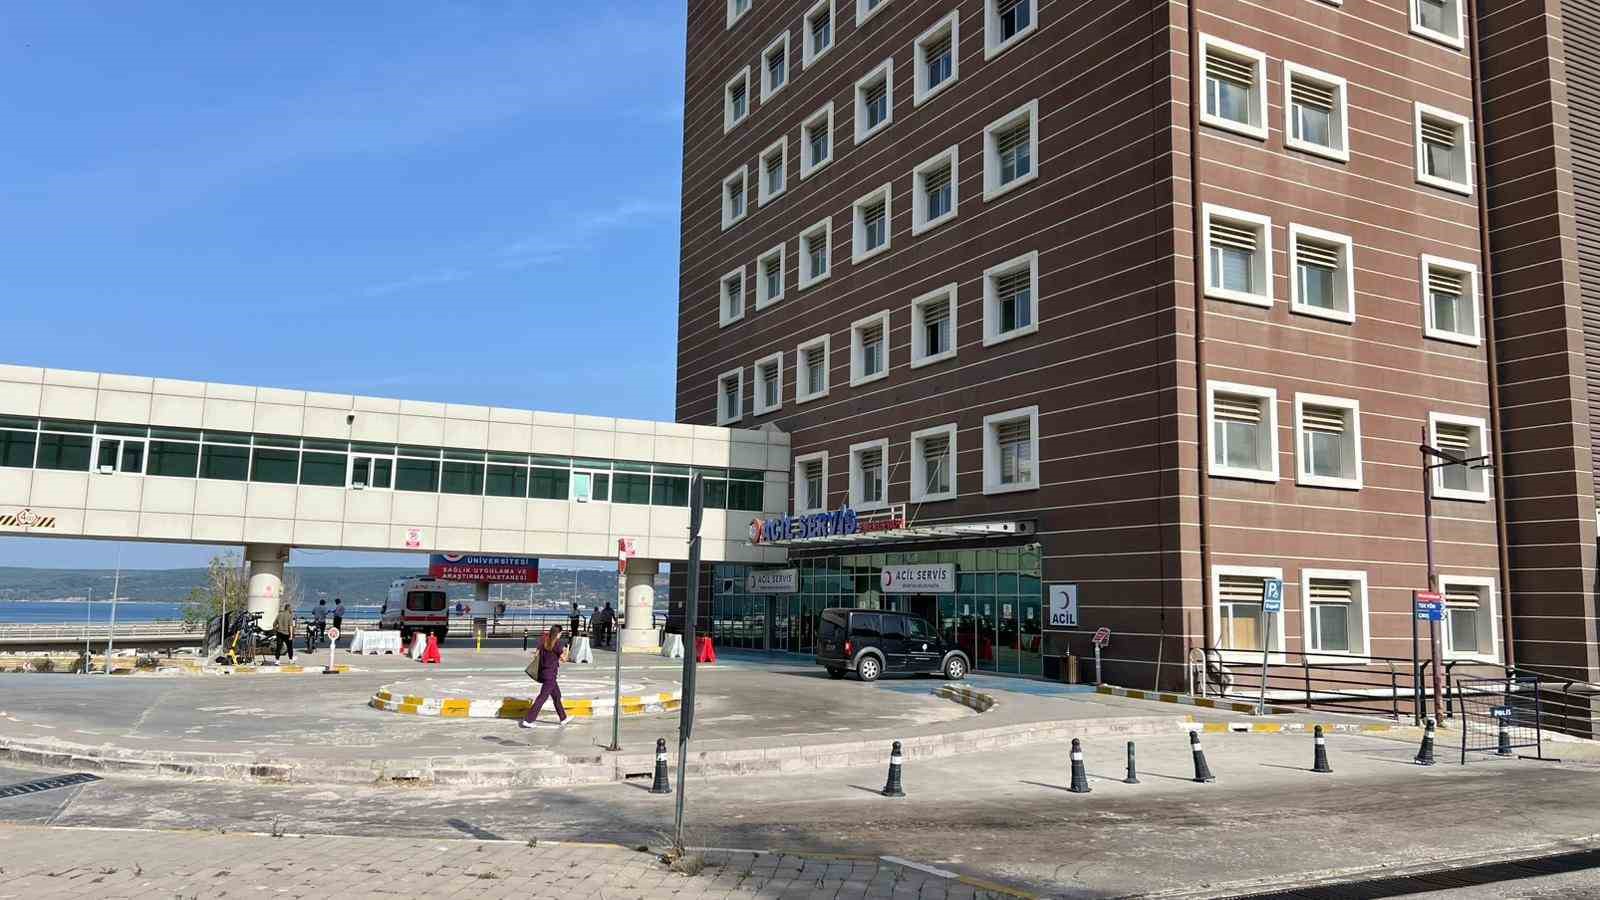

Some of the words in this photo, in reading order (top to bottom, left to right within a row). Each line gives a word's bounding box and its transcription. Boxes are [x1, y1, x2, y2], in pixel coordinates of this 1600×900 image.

[764, 511, 793, 541] ACİL
[799, 506, 856, 539] SERVİS
[895, 569, 914, 581] ACİL
[916, 567, 947, 580] SERVİS
[1052, 610, 1076, 625] ACİL
